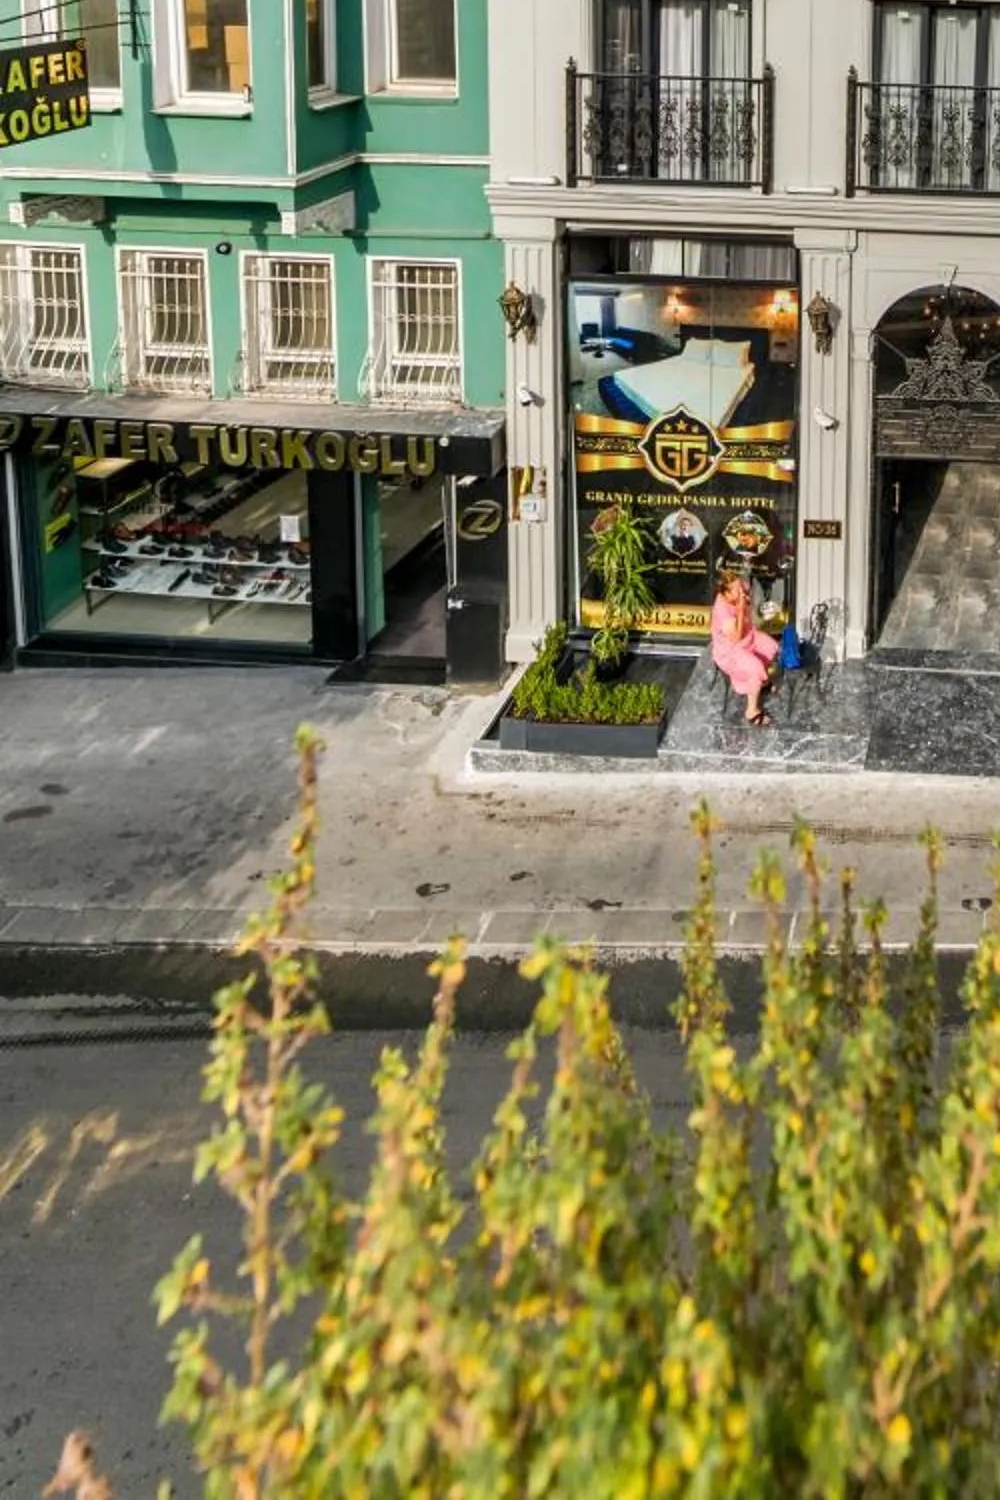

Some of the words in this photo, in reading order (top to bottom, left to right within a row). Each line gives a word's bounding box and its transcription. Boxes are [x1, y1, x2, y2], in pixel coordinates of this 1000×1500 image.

[0, 51, 85, 94] AFER
[31, 415, 178, 463] ZAFER
[189, 422, 435, 476] TÜRKOĞLU
[585, 491, 633, 503] GRAND
[731, 497, 777, 509] HOTEL
[677, 612, 705, 627] 520
